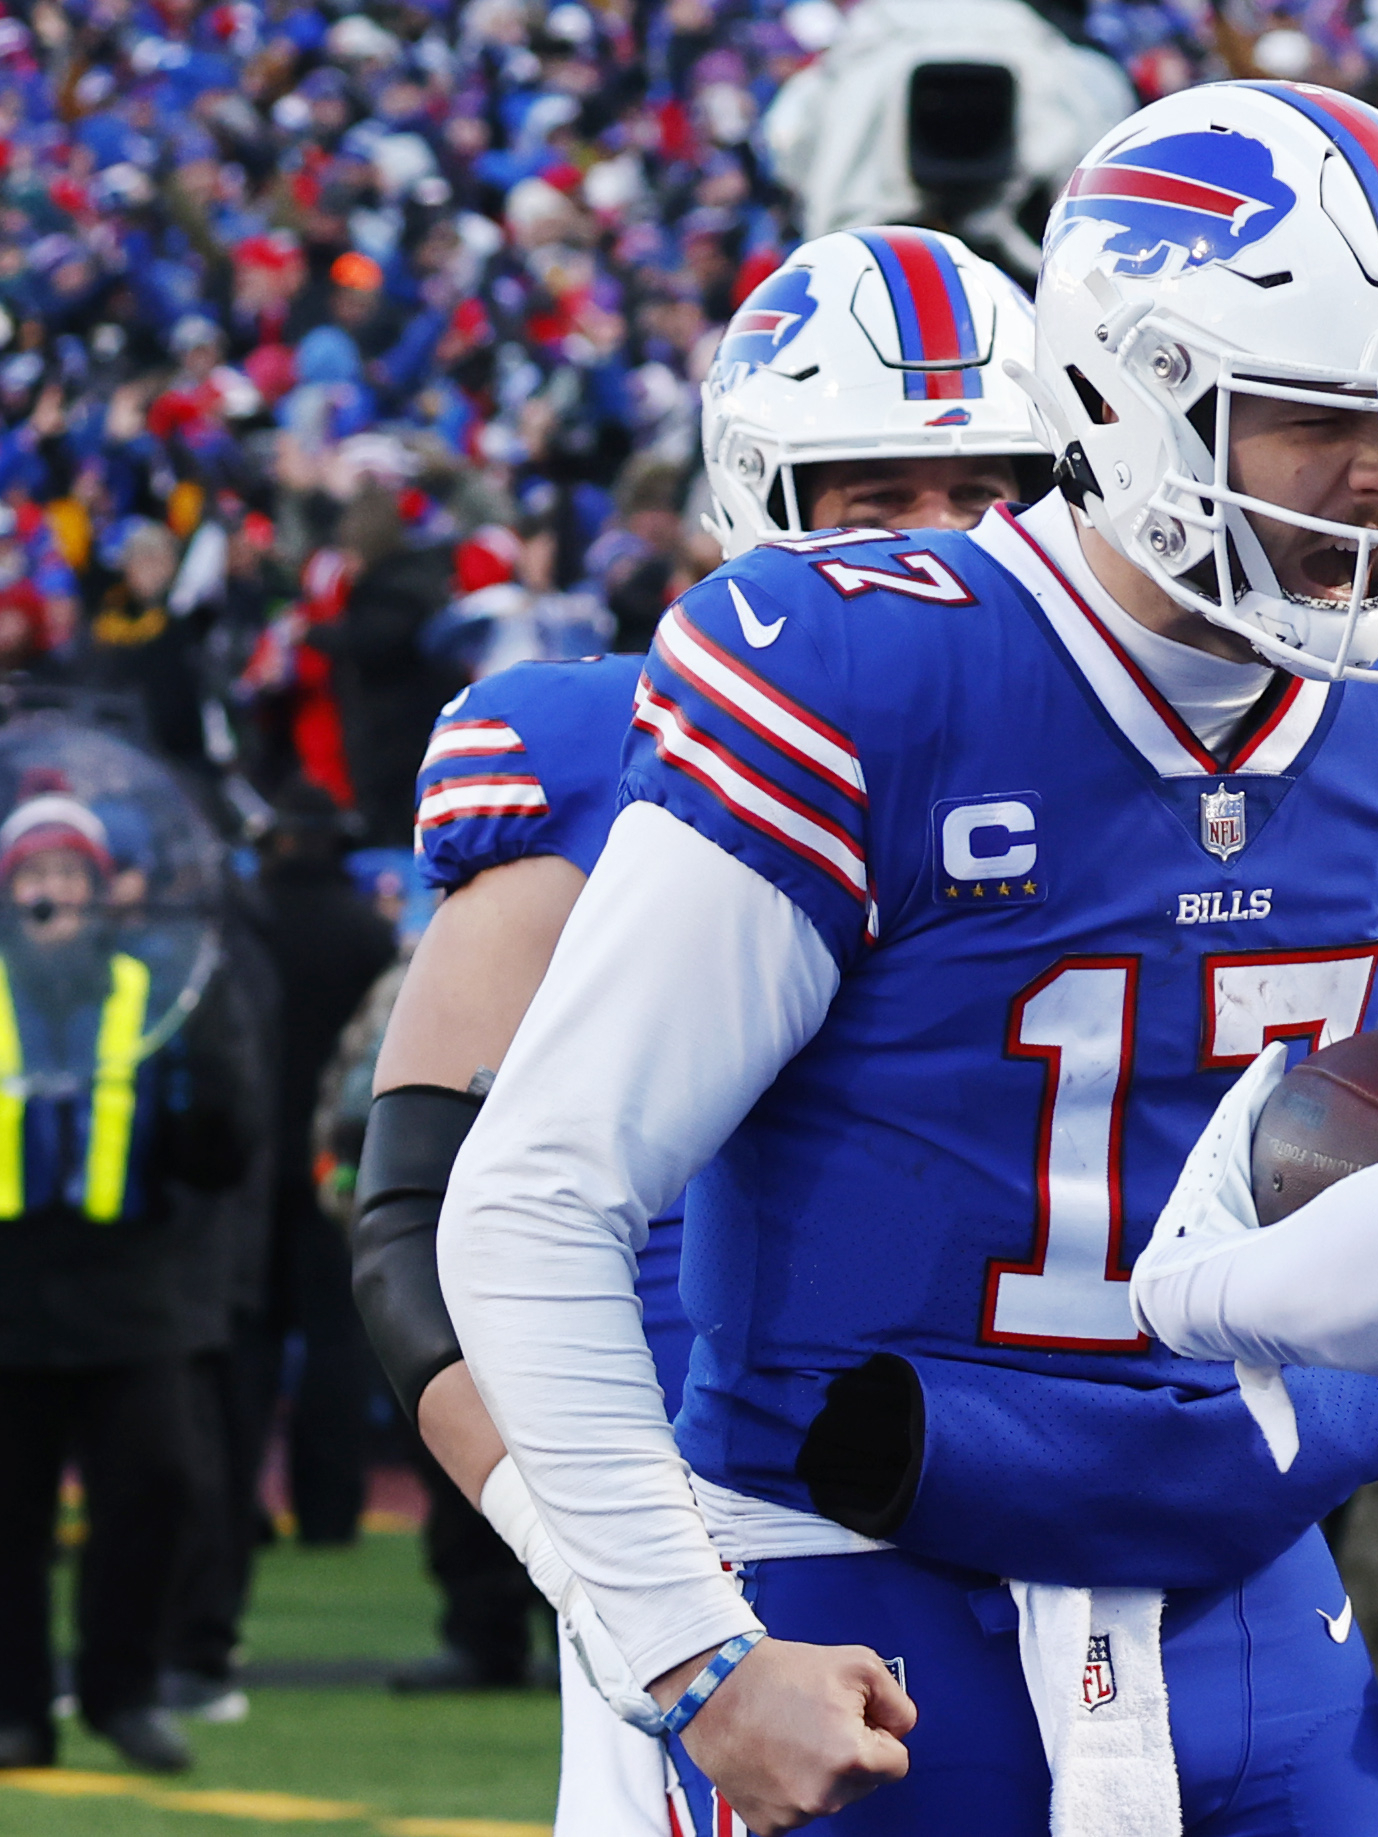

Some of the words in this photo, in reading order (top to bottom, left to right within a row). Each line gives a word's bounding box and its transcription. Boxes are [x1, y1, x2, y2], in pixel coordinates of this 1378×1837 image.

[755, 527, 982, 607] 17
[942, 800, 1037, 881] C
[1208, 819, 1240, 847] NFL
[1175, 888, 1273, 925] BILLS
[1312, 1151, 1362, 1174] IONAL
[1082, 1664, 1111, 1705] FL
